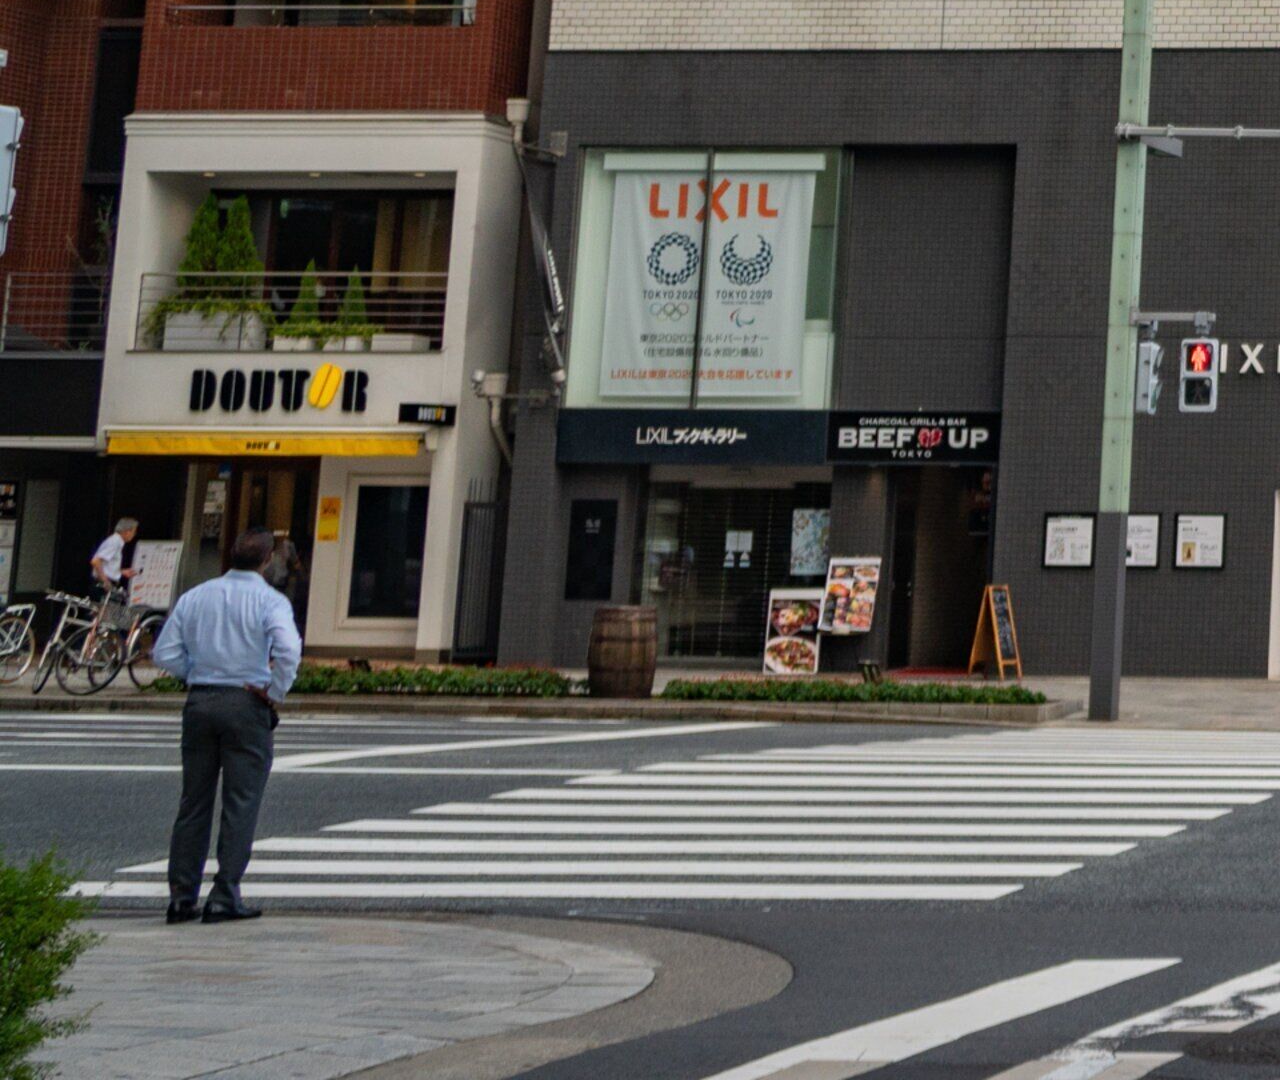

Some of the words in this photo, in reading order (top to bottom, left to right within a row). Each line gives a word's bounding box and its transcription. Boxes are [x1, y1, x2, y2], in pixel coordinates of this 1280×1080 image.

[649, 178, 778, 223] LIXIL
[643, 289, 674, 301] TOKYO
[716, 289, 748, 300] TOKYO
[750, 289, 773, 300] 2020
[189, 362, 369, 412] DOUTOR
[859, 417, 909, 426] CHARCOAL
[910, 417, 938, 426] GRILL
[939, 417, 945, 426] &
[947, 417, 967, 426] BAR
[838, 427, 915, 449] BEEF
[948, 427, 989, 449] UP
[891, 450, 932, 459] TOKYO
